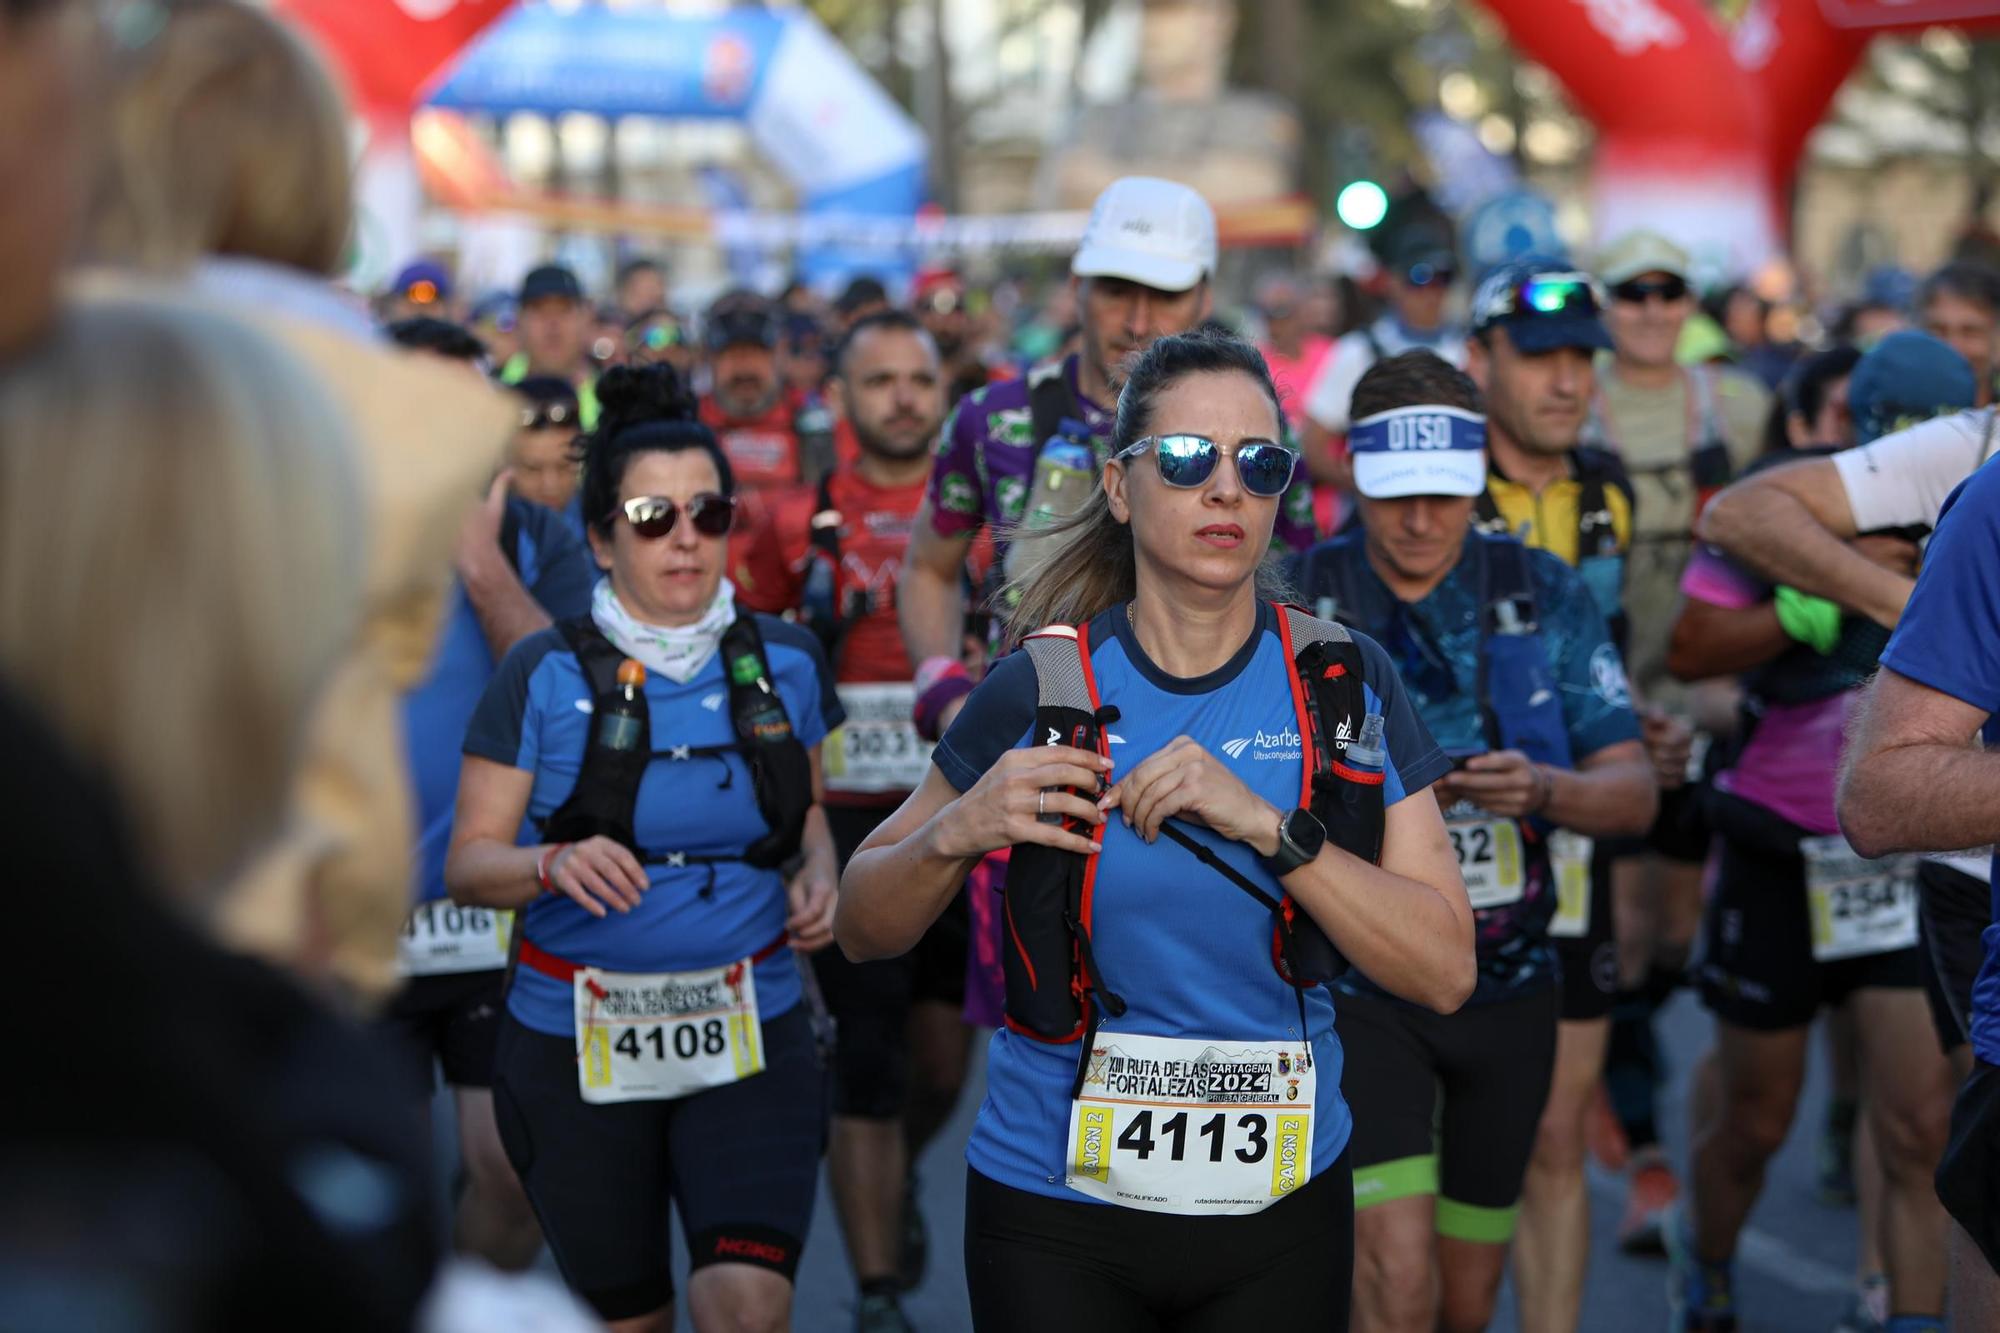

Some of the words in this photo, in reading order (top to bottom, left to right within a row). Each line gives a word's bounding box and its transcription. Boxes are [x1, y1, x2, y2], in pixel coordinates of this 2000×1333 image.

[615, 1019, 725, 1061] 4108
[1109, 1056, 1124, 1074] XIII
[1127, 1058, 1160, 1076] RUTA
[1163, 1061, 1180, 1078] DE
[1183, 1062, 1208, 1079] LAS
[1210, 1063, 1271, 1074] CARTAGENA
[1106, 1073, 1207, 1098] FORTALEZAS
[1209, 1074, 1270, 1091] 2024
[1240, 1093, 1280, 1103] GENERAL
[1087, 1112, 1104, 1123] 2
[1283, 1120, 1300, 1131] 2
[1117, 1110, 1268, 1164] 4113
[1083, 1126, 1103, 1176] CAJON
[1279, 1134, 1298, 1193] CAJON
[1116, 1191, 1168, 1204] DESCALIFICADO
